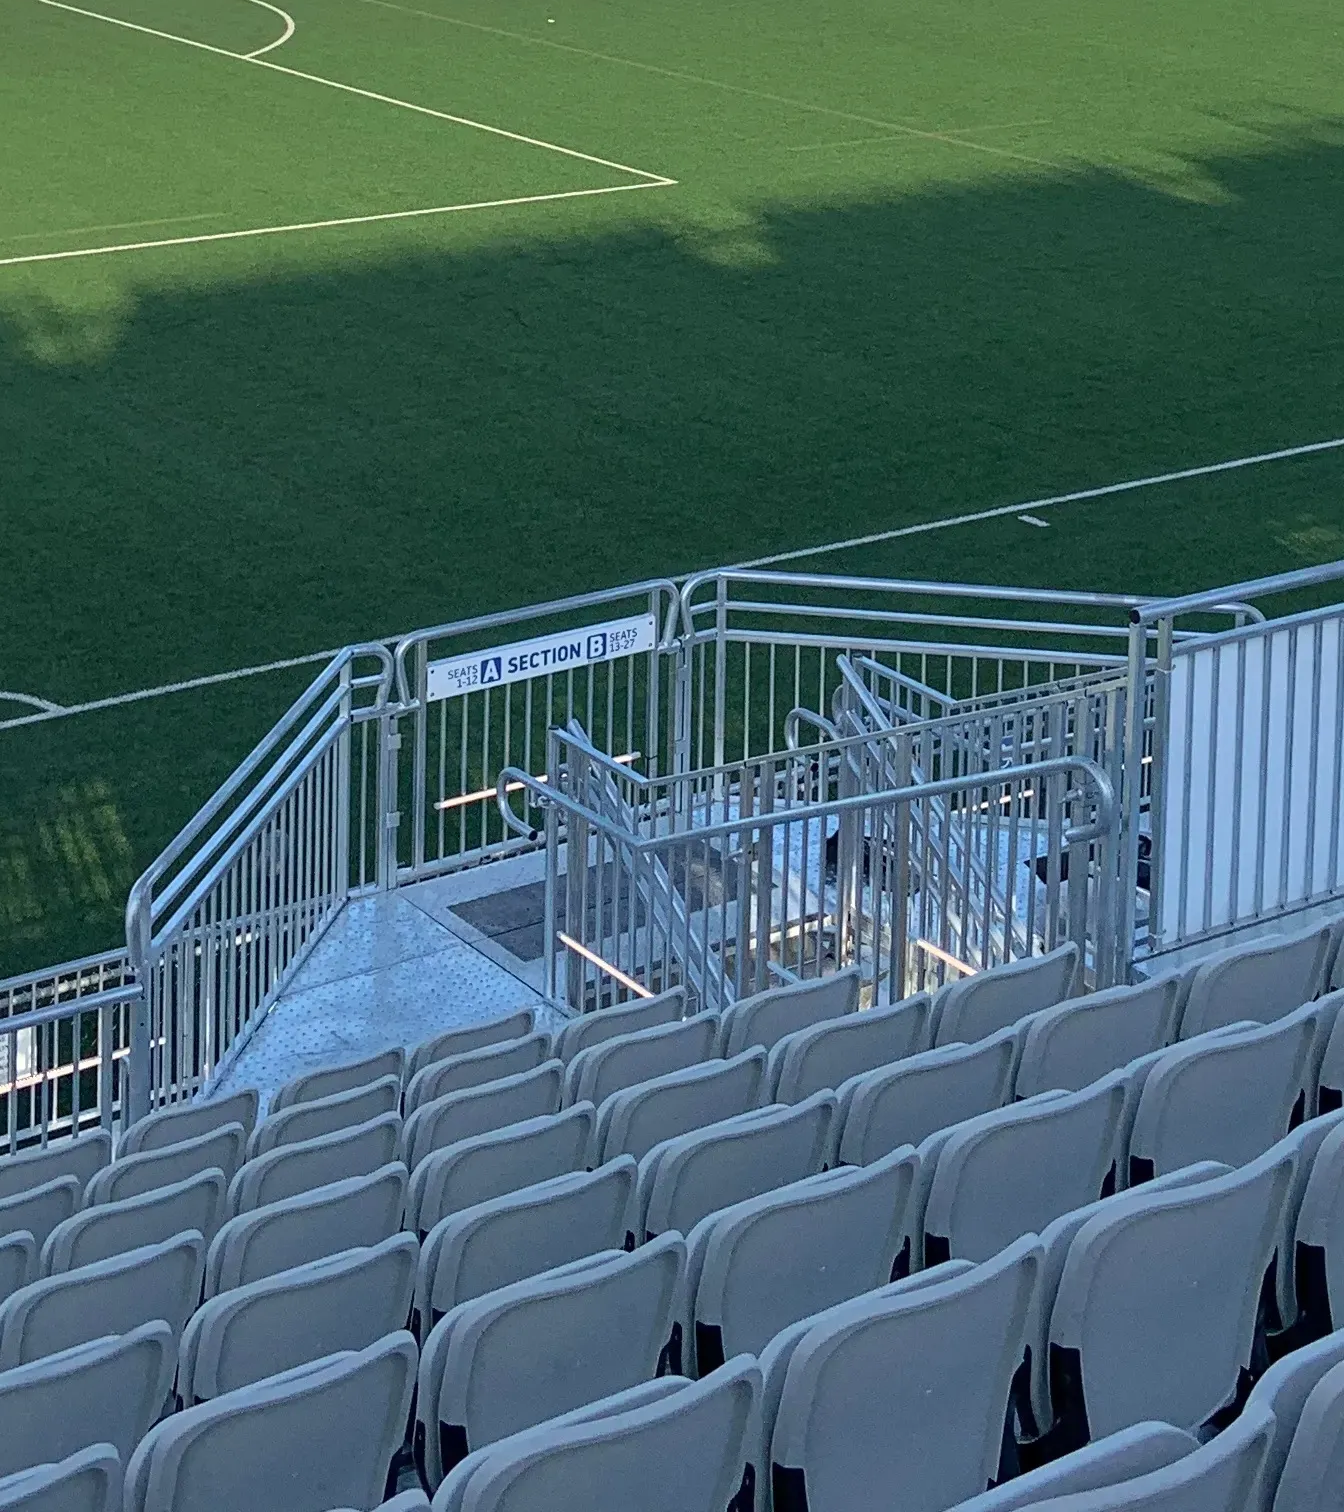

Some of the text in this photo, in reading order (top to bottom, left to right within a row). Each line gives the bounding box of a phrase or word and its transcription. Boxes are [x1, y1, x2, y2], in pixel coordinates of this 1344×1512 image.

[609, 628, 638, 642] SEATS
[610, 638, 636, 653] 13-27
[482, 635, 605, 683] A SECTION B
[447, 664, 478, 680] SEATS
[457, 675, 478, 688] 1-12
